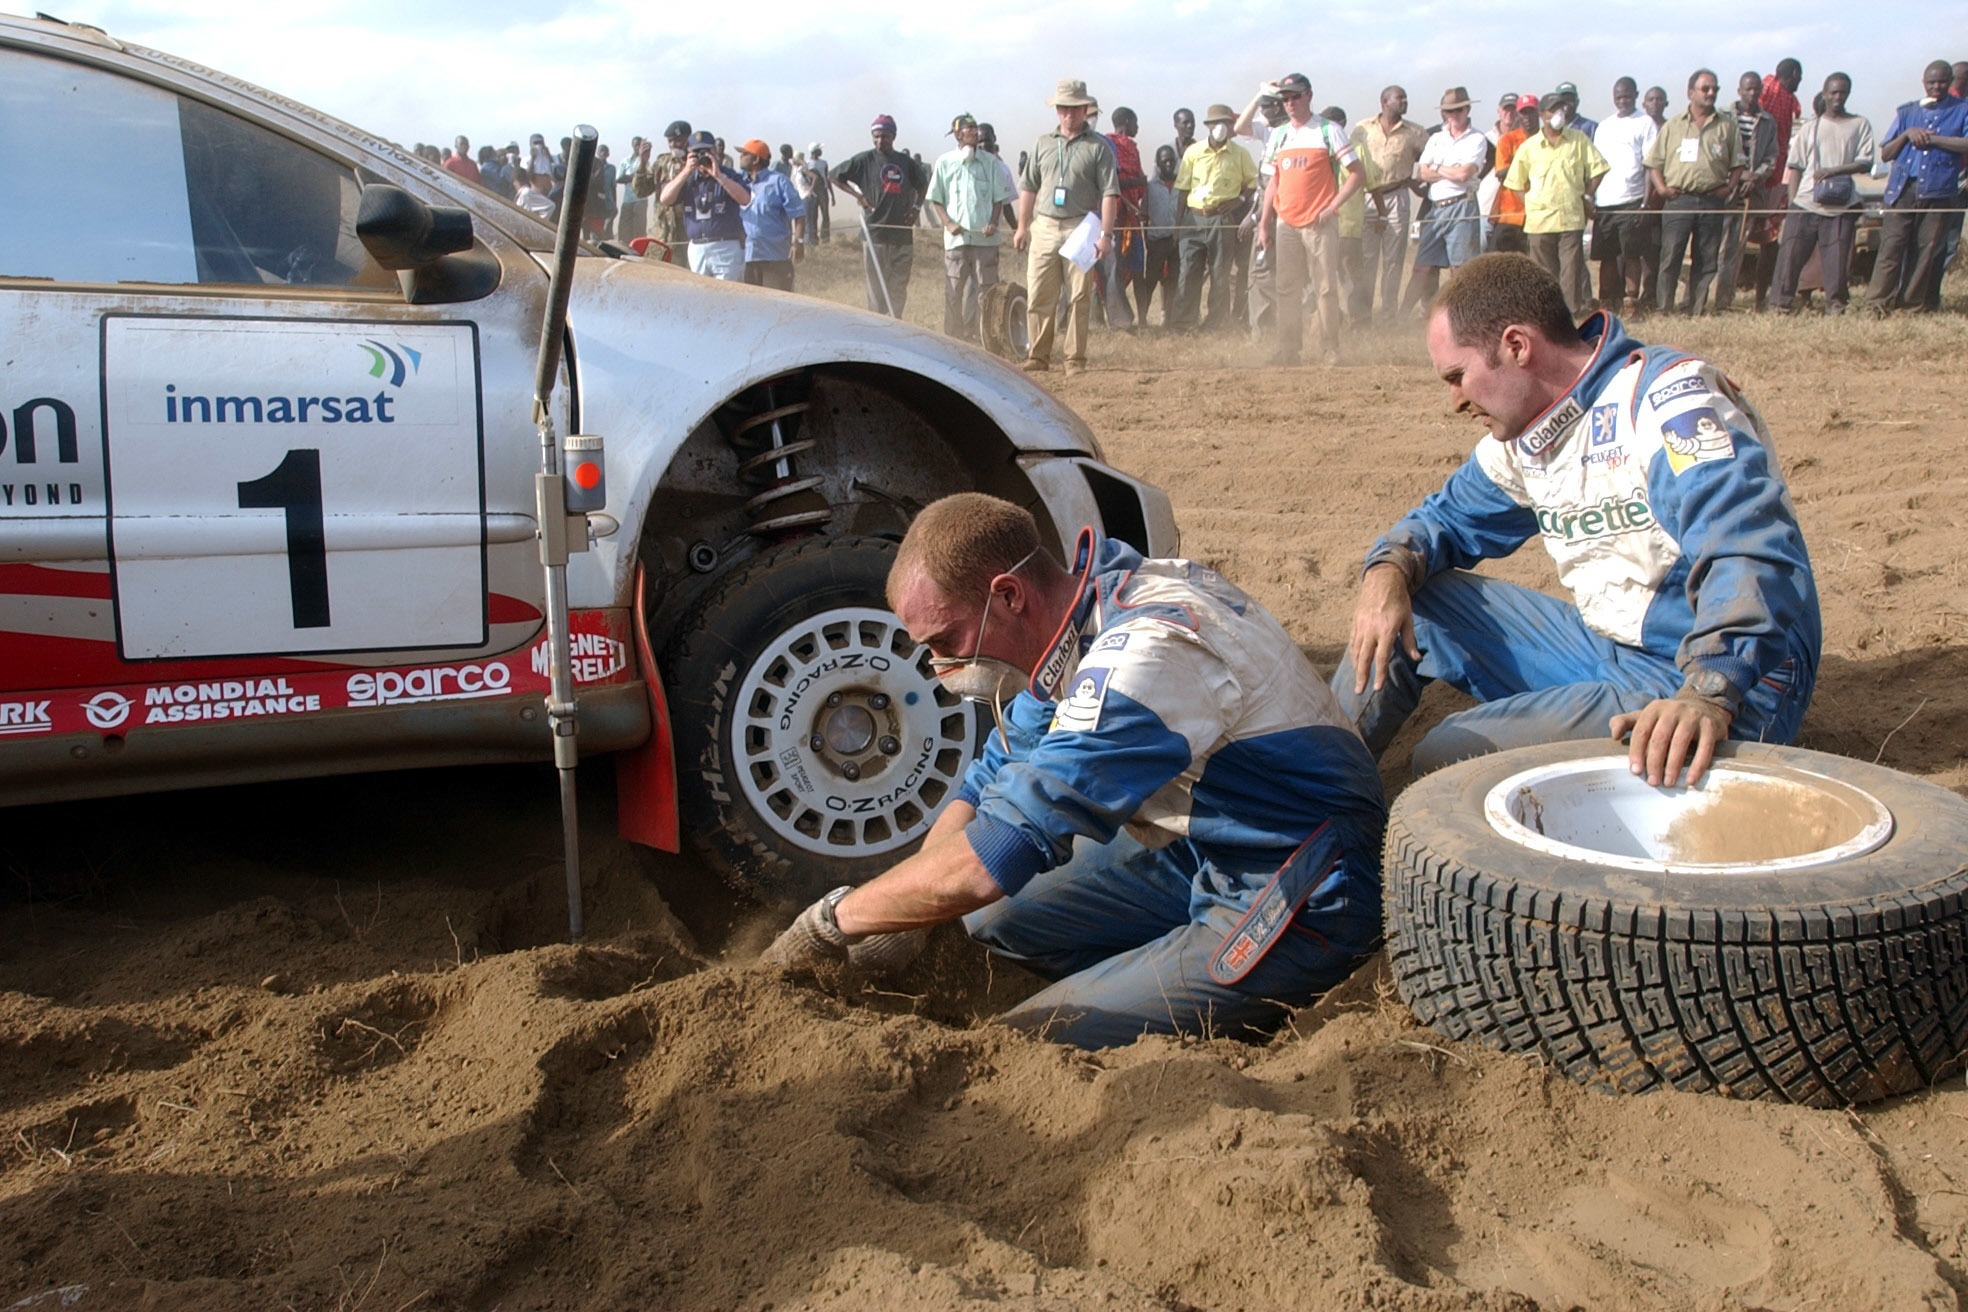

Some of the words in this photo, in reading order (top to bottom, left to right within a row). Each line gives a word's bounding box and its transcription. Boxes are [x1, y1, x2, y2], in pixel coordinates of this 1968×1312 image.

[166, 384, 395, 424] inmarsat
[237, 448, 331, 630] 1
[145, 677, 294, 706] MONDIAL
[346, 661, 511, 707] sparco
[145, 694, 321, 724] ASSISTANCE
